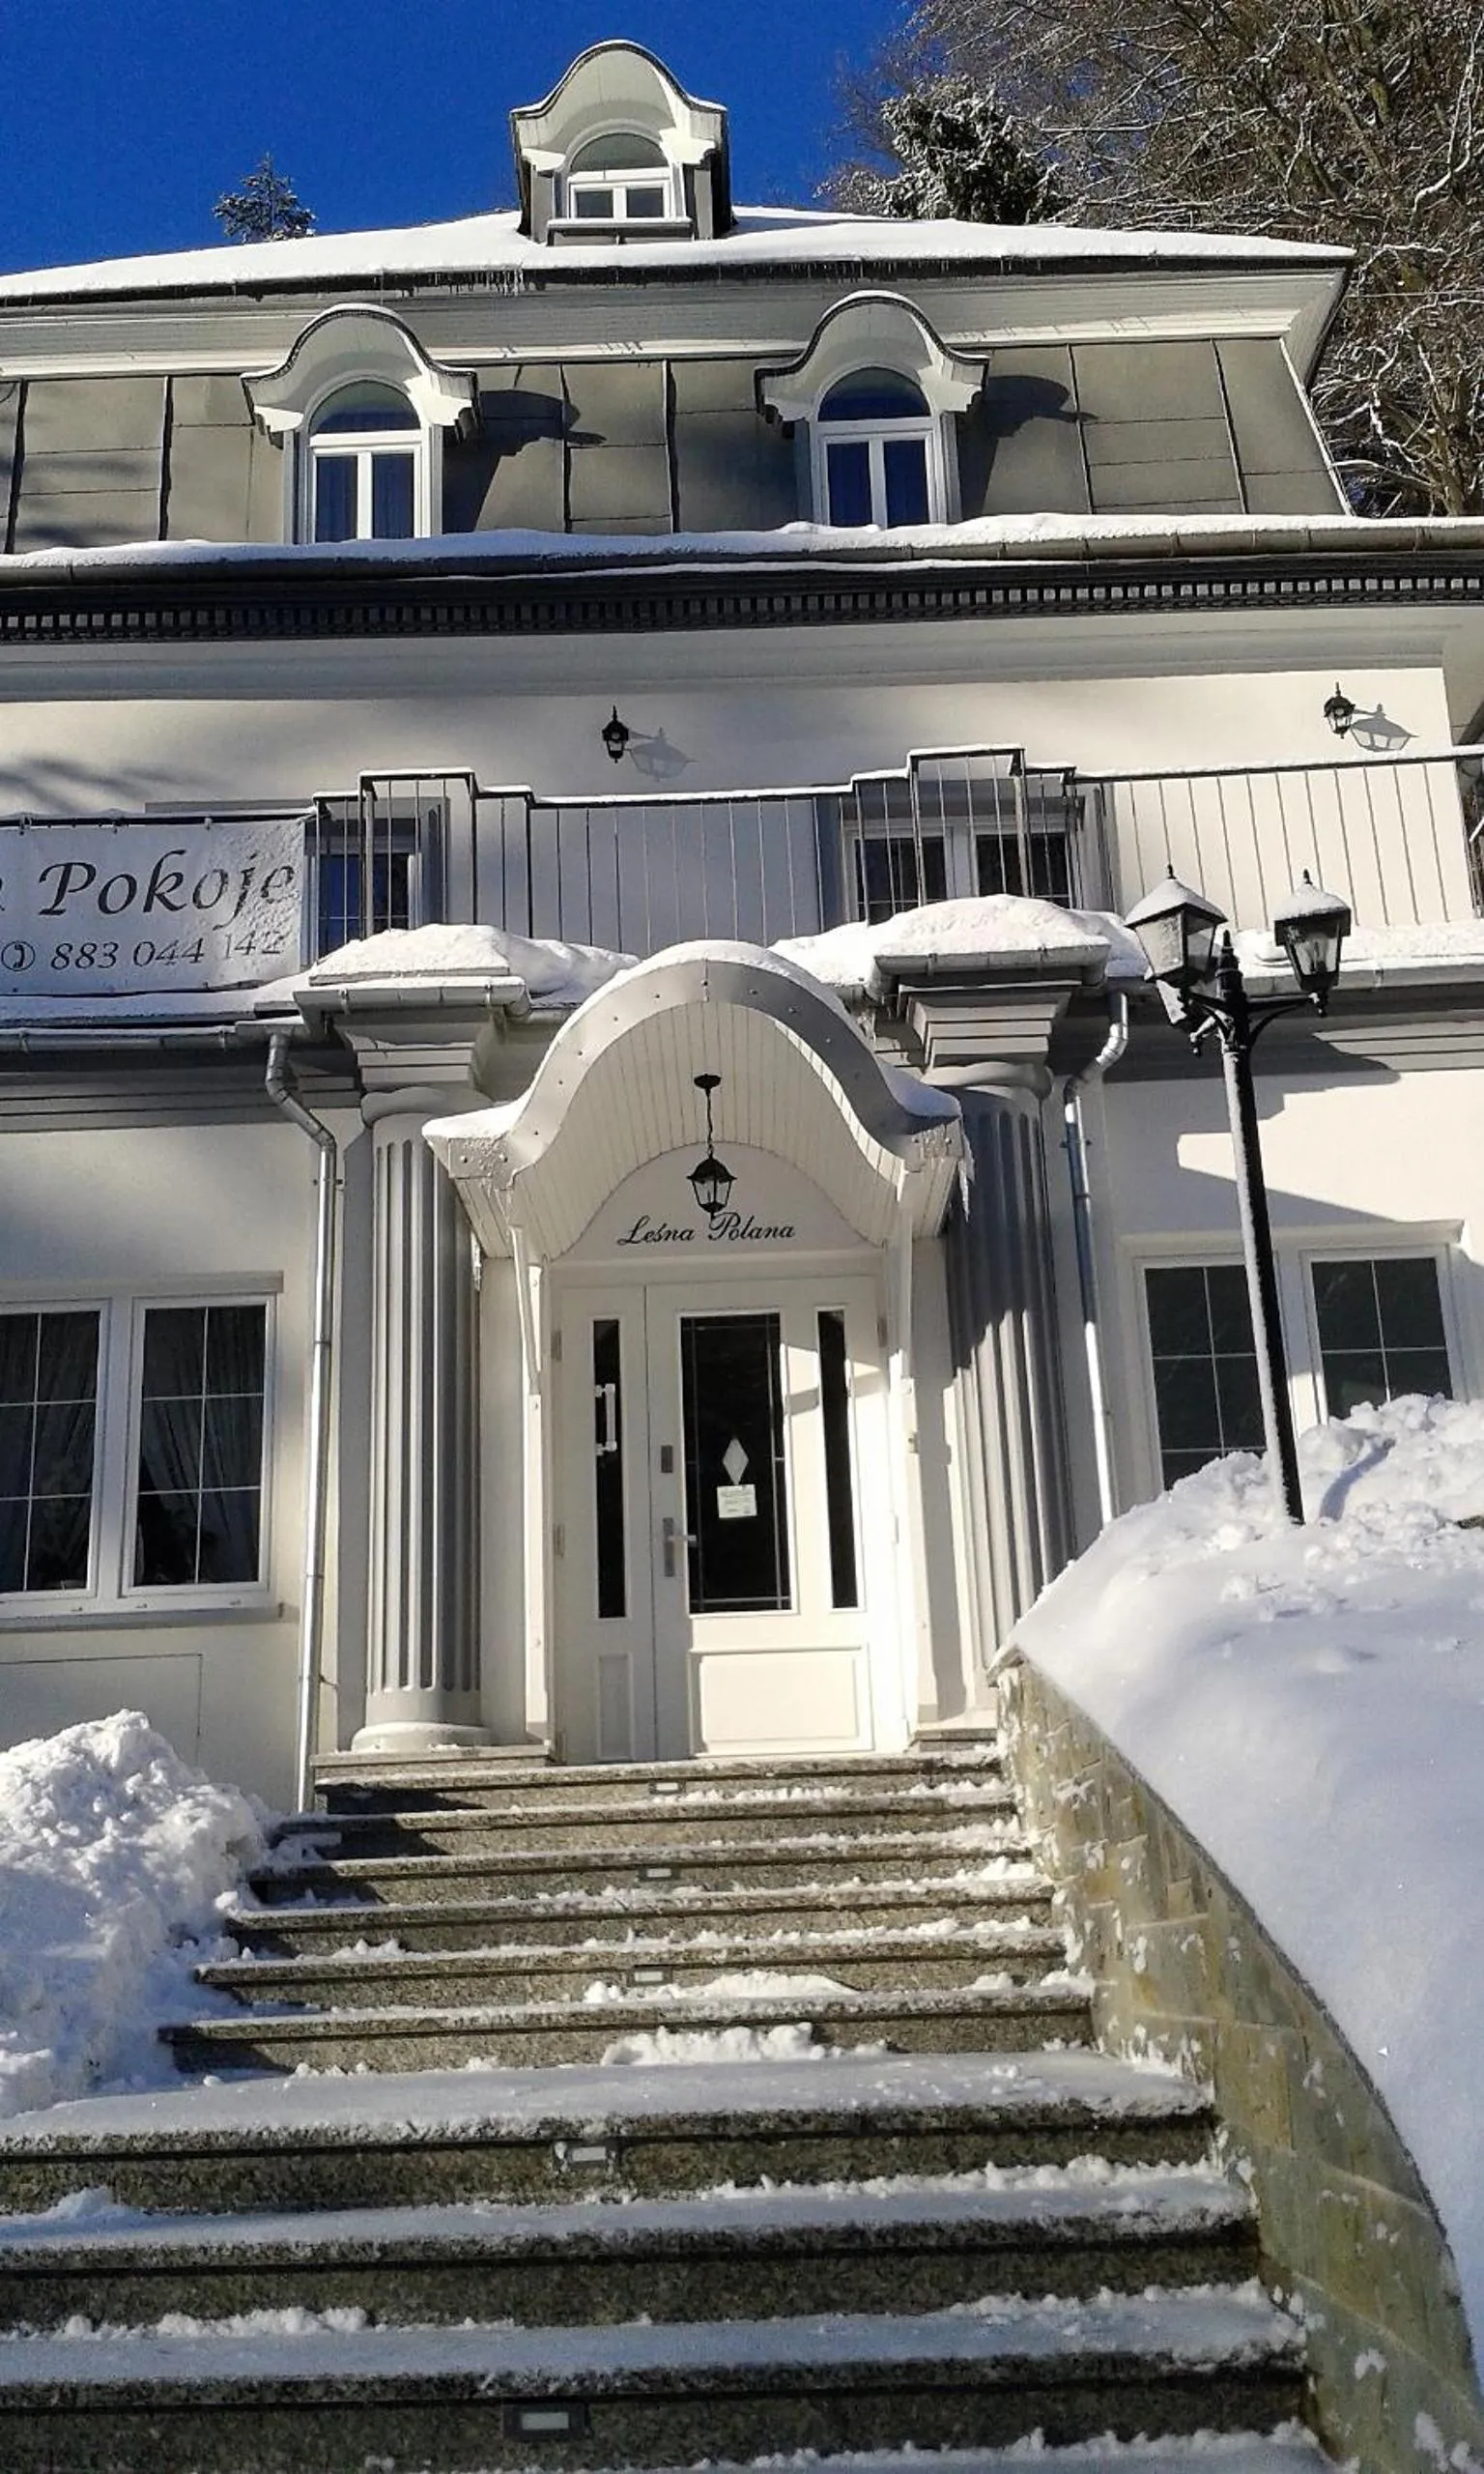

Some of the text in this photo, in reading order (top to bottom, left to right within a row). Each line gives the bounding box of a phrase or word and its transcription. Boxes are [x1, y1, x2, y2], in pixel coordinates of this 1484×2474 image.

[39, 849, 295, 931] Pokoje
[50, 941, 119, 970] 883
[133, 937, 205, 967] 044
[616, 1211, 795, 1247] Leśna Polana
